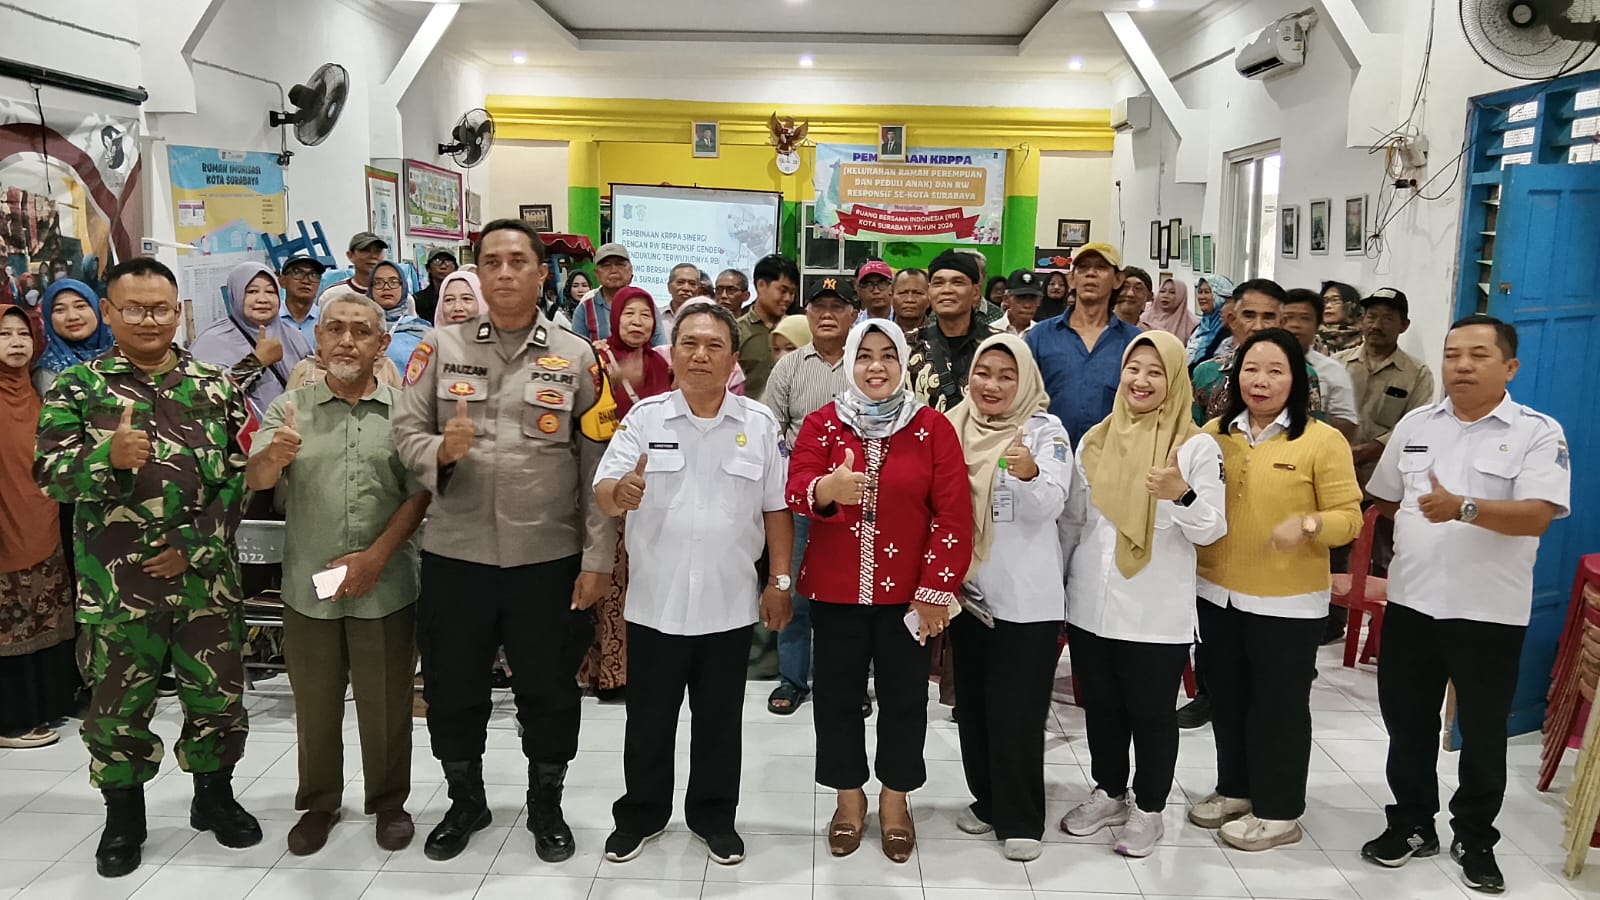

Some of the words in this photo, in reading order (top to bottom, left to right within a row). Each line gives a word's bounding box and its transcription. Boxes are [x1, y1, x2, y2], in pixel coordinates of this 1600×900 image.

[853, 153, 927, 163] PEMAN
[930, 155, 972, 165] KRPPA
[201, 163, 228, 173] RUMAH
[229, 165, 261, 174] IMUNISASI
[844, 167, 896, 176] (KELURAHAN
[898, 169, 929, 177] RAMAH
[931, 170, 982, 178] PEREMPUAN
[206, 175, 225, 184] KOTA
[226, 176, 259, 185] SURABAYA
[875, 179, 903, 187] PEDULI
[905, 180, 933, 189] ANAK)
[847, 189, 891, 198] RESPONSIF
[894, 190, 929, 199] SE-KOTA
[931, 191, 976, 200] SURABAYA
[855, 209, 878, 219] RUANG
[879, 214, 908, 222] BERSAMA
[858, 219, 876, 227] KOTA
[877, 223, 911, 231] SURABAYA
[622, 229, 659, 238] PEMBINAAN
[661, 232, 681, 240] KRPPA
[683, 234, 707, 242] SINERGI
[622, 240, 648, 248] DENGAN
[661, 243, 695, 252] RESPONSIF
[697, 245, 721, 254] GENDER
[630, 252, 661, 260] NDUKUNG
[662, 254, 709, 264] TERWUJUDNYA
[639, 276, 667, 284] SURABAY
[443, 363, 488, 376] FAUZAN
[531, 372, 574, 385] POLRI
[238, 552, 264, 562] 022
